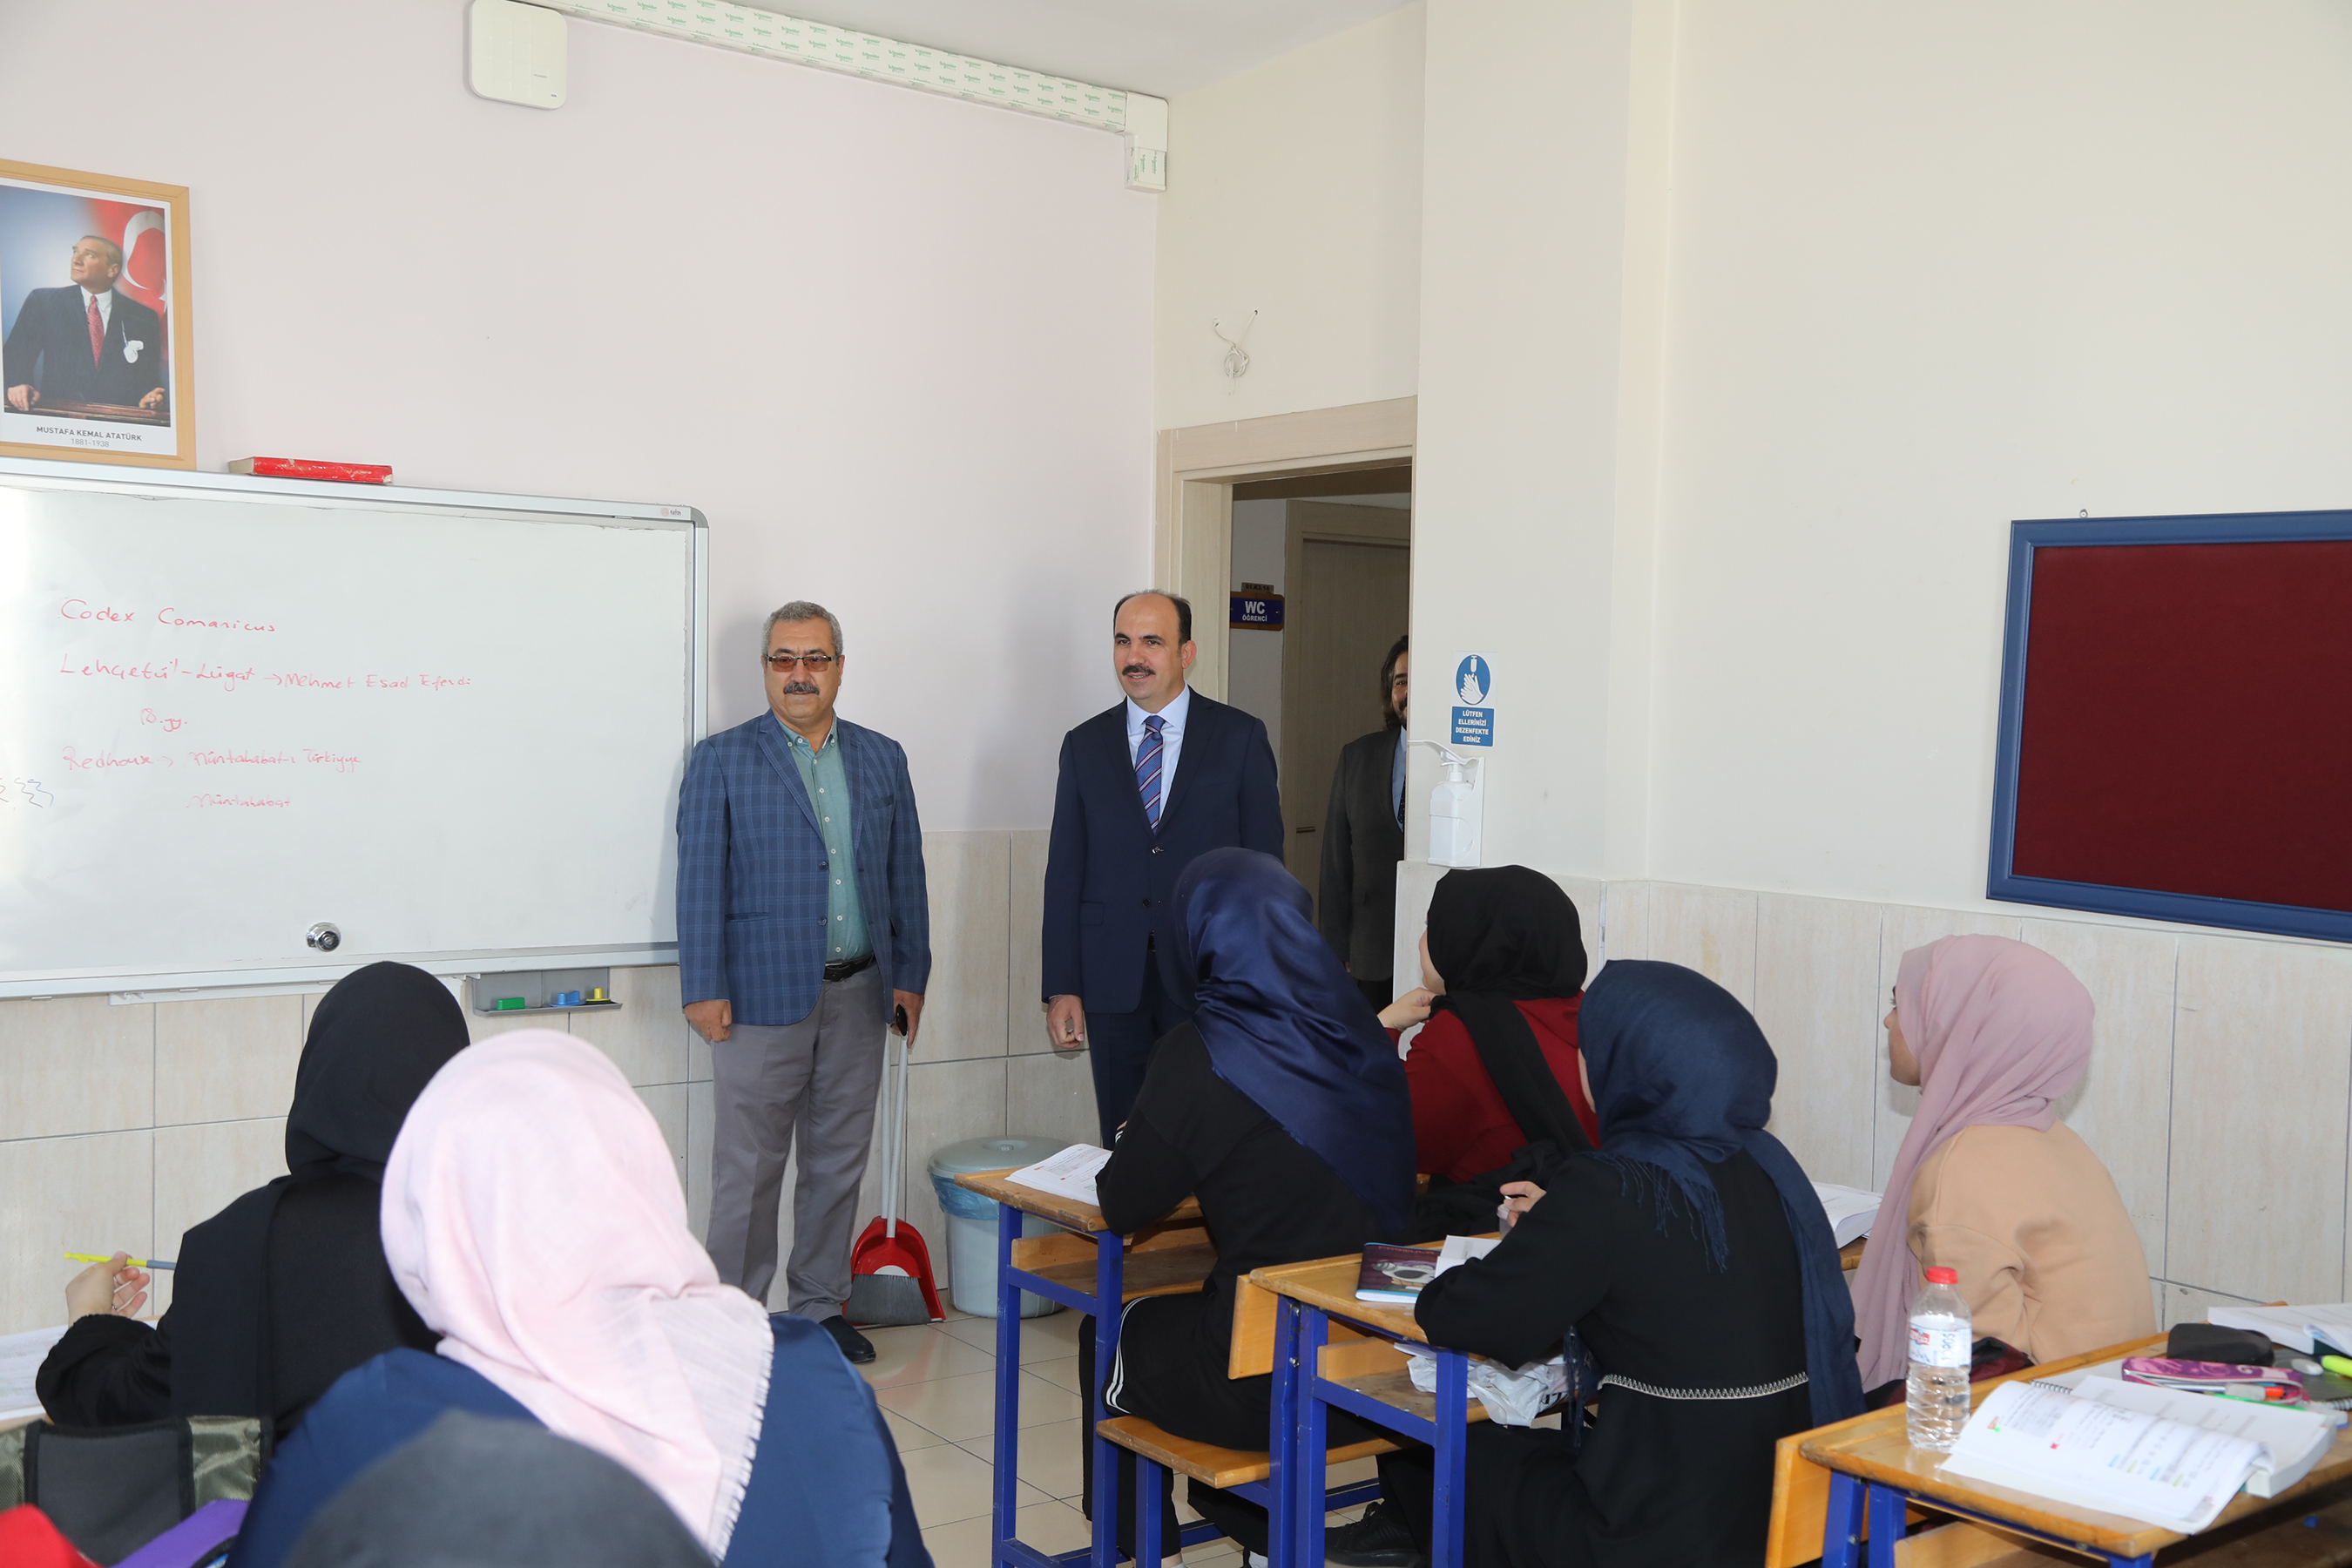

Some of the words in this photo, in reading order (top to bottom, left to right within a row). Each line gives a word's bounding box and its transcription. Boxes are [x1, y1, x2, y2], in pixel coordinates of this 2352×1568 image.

[36, 426, 75, 436] MUSTAFA
[77, 429, 104, 438] KEMAL
[105, 432, 142, 441] ATATÜRK
[71, 438, 110, 447] 1881-1938
[1245, 600, 1266, 614] WC
[61, 598, 135, 621] Codex
[159, 607, 275, 632] Comanicus
[1242, 613, 1267, 622] ÖĞRENCİ
[366, 673, 409, 689] Esad
[1462, 709, 1484, 718] LÜTFEN
[1458, 718, 1487, 727] ELLERİNİZİ
[1455, 727, 1490, 735] DEZENFEKTE
